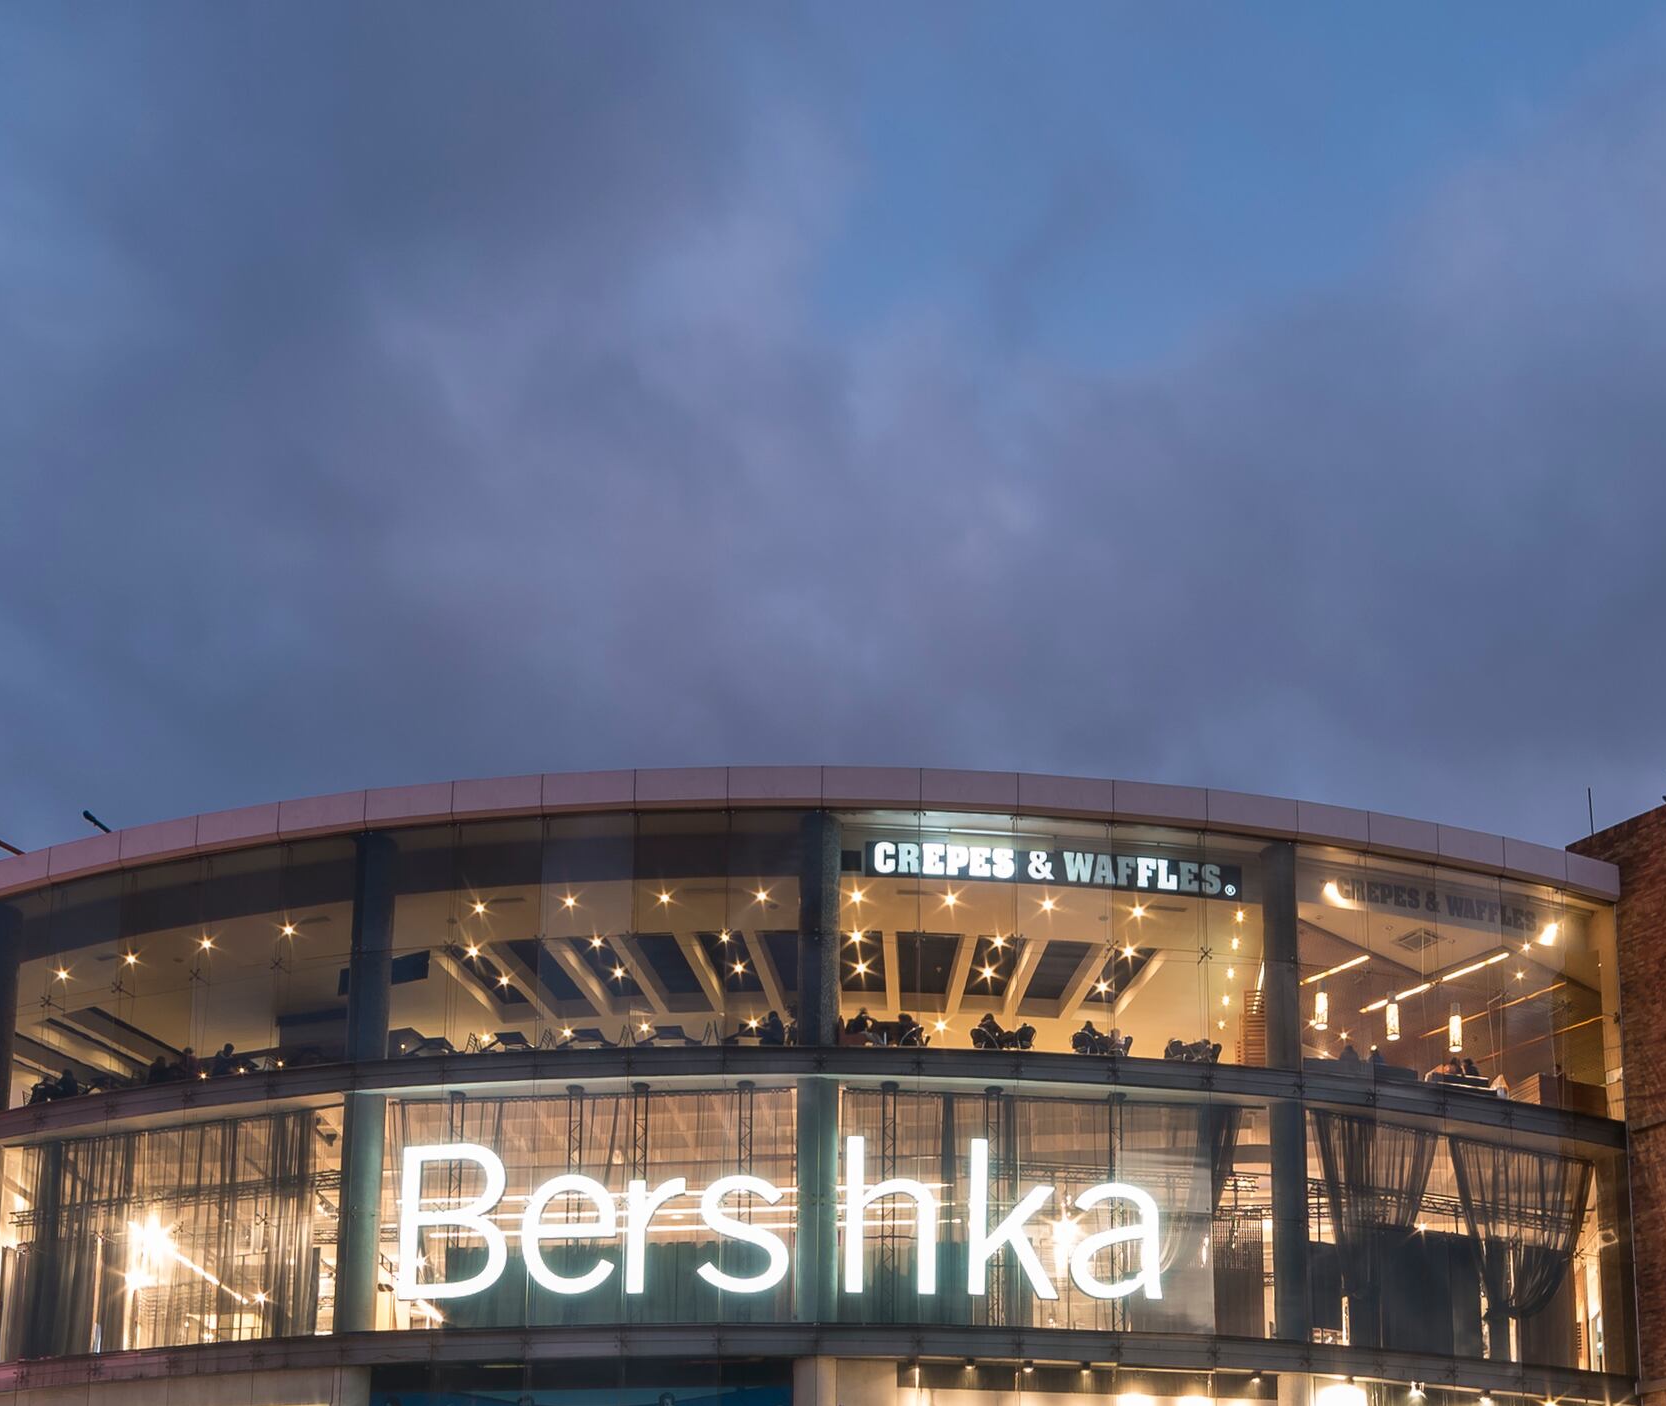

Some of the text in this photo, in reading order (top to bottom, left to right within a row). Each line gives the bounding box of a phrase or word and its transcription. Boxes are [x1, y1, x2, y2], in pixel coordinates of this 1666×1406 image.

[873, 840, 1015, 880] CREPES
[1028, 849, 1055, 881] &
[1445, 895, 1537, 932] WAFFLES
